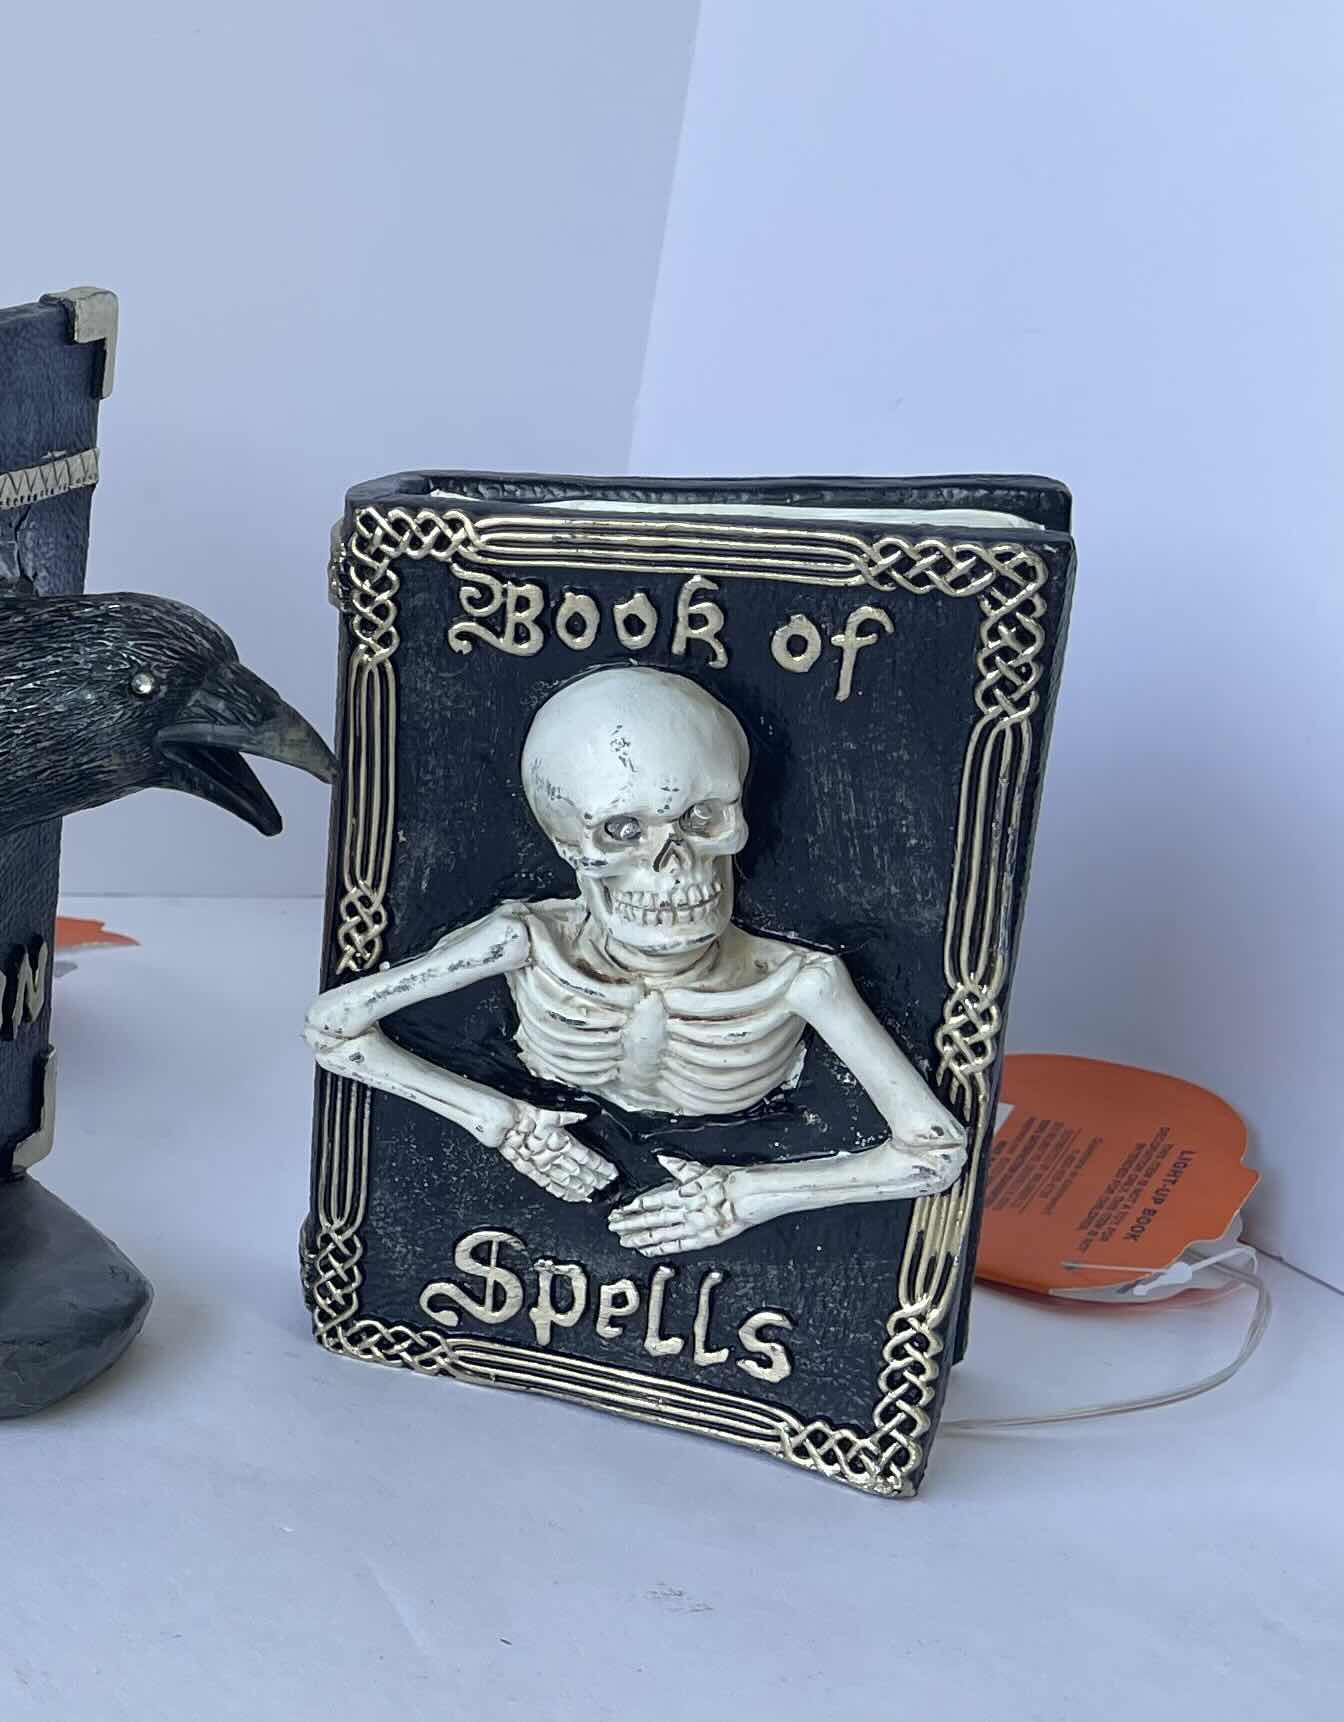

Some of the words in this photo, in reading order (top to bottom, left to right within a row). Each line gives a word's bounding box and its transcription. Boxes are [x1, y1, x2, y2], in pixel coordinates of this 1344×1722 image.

[447, 562, 728, 667] Book
[770, 604, 895, 702] of
[1124, 1208, 1158, 1242] BOOK
[1153, 1150, 1196, 1205] LIGHT-UP
[420, 1230, 794, 1385] Spells
